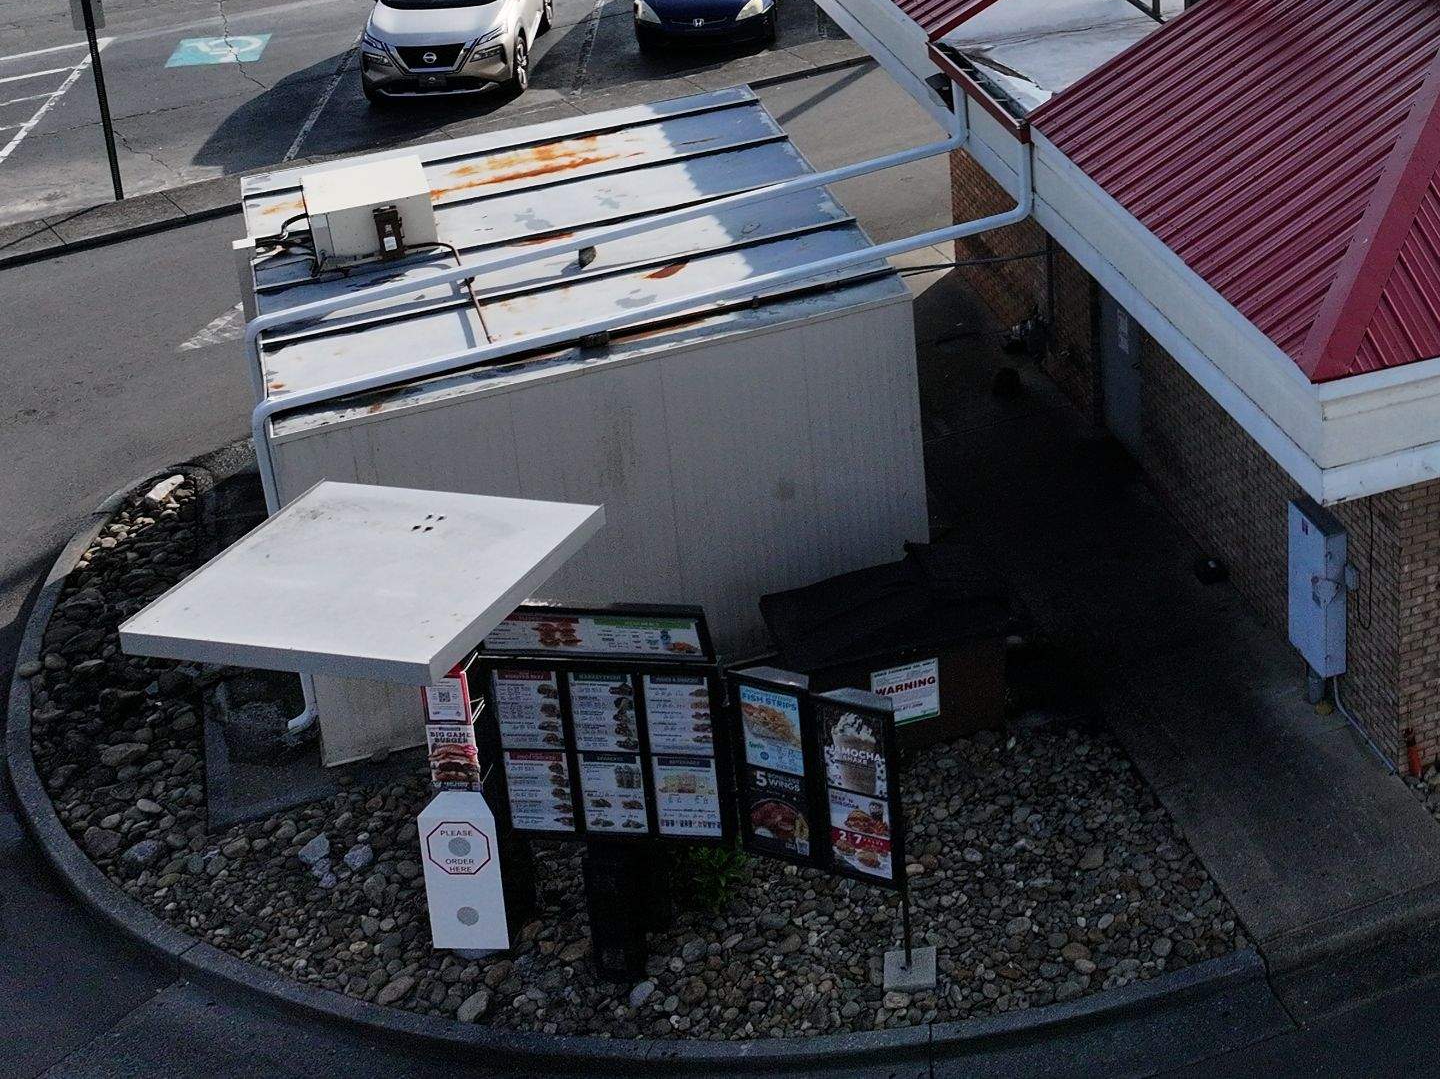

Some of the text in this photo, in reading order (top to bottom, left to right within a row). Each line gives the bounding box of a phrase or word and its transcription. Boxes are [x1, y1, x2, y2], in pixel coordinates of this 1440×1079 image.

[875, 676, 936, 696] WARNING
[755, 770, 768, 787] 5
[440, 829, 474, 837] PLEASE
[445, 857, 474, 865] ORDER
[449, 865, 472, 873] HERE
